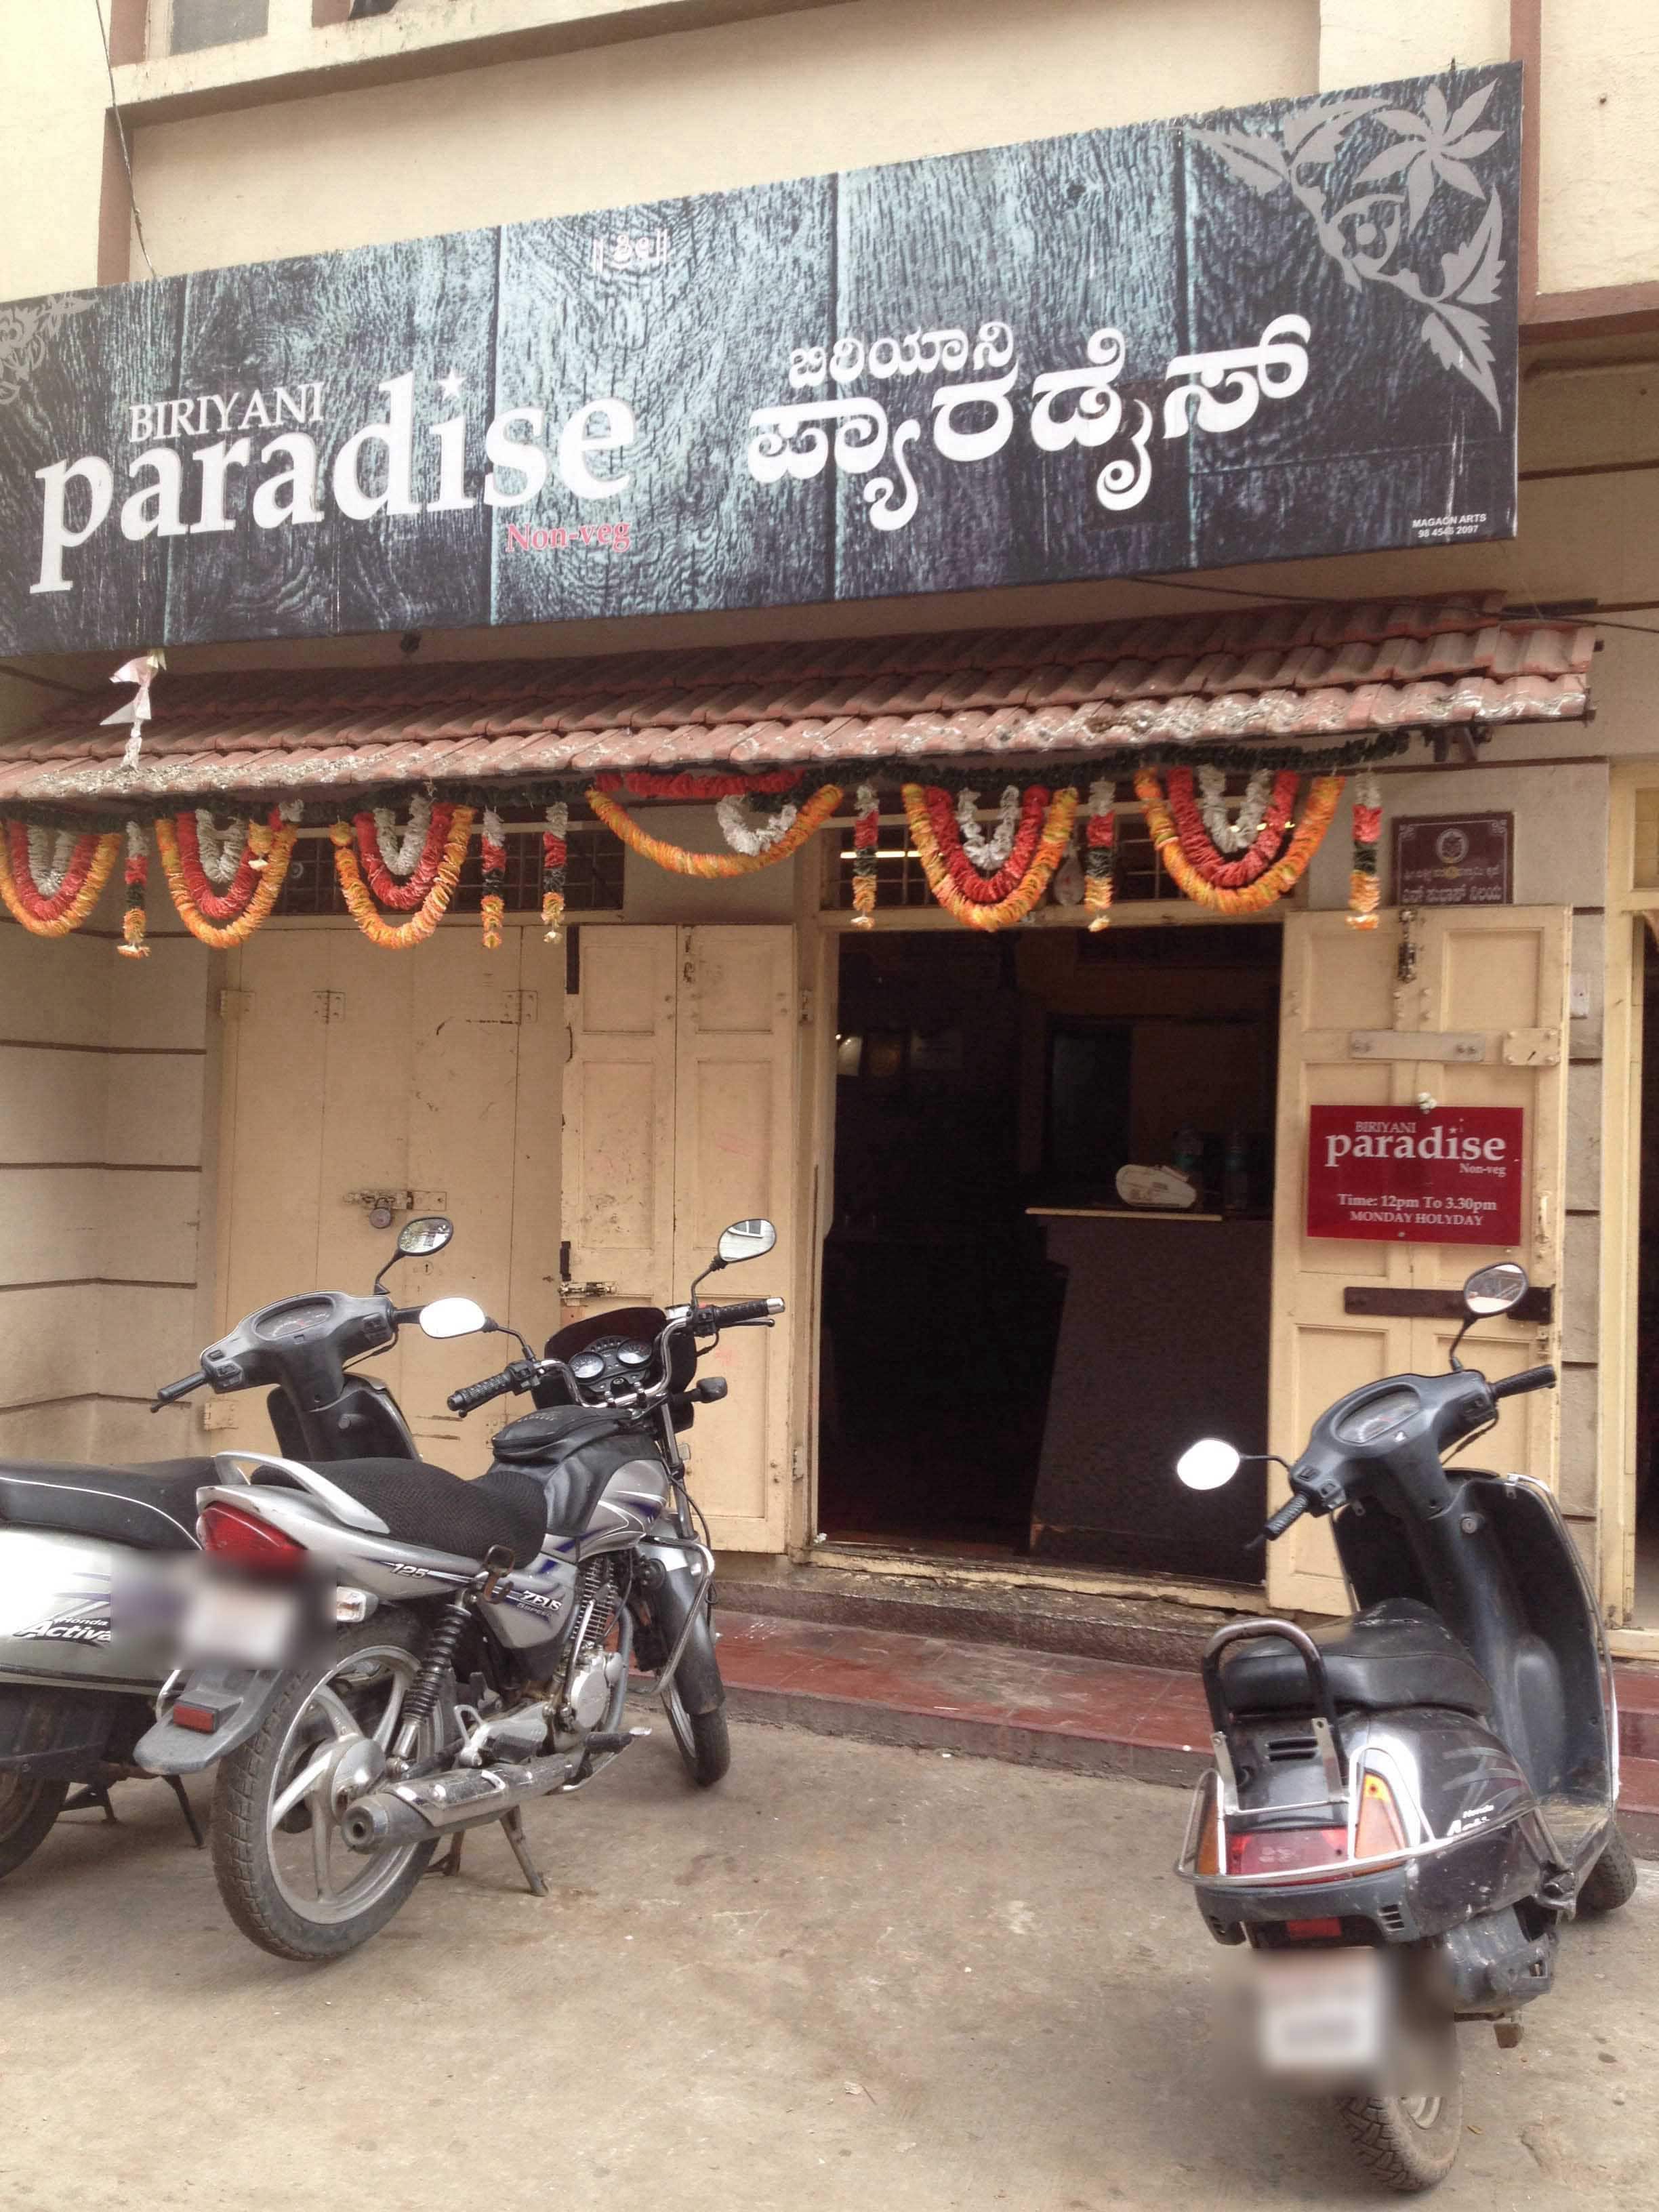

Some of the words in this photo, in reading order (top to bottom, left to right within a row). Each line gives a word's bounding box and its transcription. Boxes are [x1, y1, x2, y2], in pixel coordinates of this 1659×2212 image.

[789, 321, 1015, 389] ಬಿರಿಯಾನಿ
[129, 383, 325, 443] BIRIYANI
[747, 313, 1311, 531] ಪ್ಯಾರಡೈಸ್
[29, 369, 636, 594] paradise
[1458, 513, 1487, 523] ARTS
[506, 521, 632, 552] Non-veg
[1355, 1121, 1416, 1134] BIRIYANI
[1324, 1126, 1507, 1168] paradise
[1459, 1163, 1507, 1178] Non-veg
[1337, 1193, 1378, 1206] Time:
[1380, 1195, 1419, 1211] 12pm
[1422, 1197, 1442, 1209] To
[1445, 1197, 1497, 1214] 3.30pm
[1349, 1210, 1412, 1223] MONDAY
[1414, 1212, 1483, 1226] HOLYDAY
[390, 1563, 430, 1578] 125
[520, 1589, 562, 1611] ZEUS
